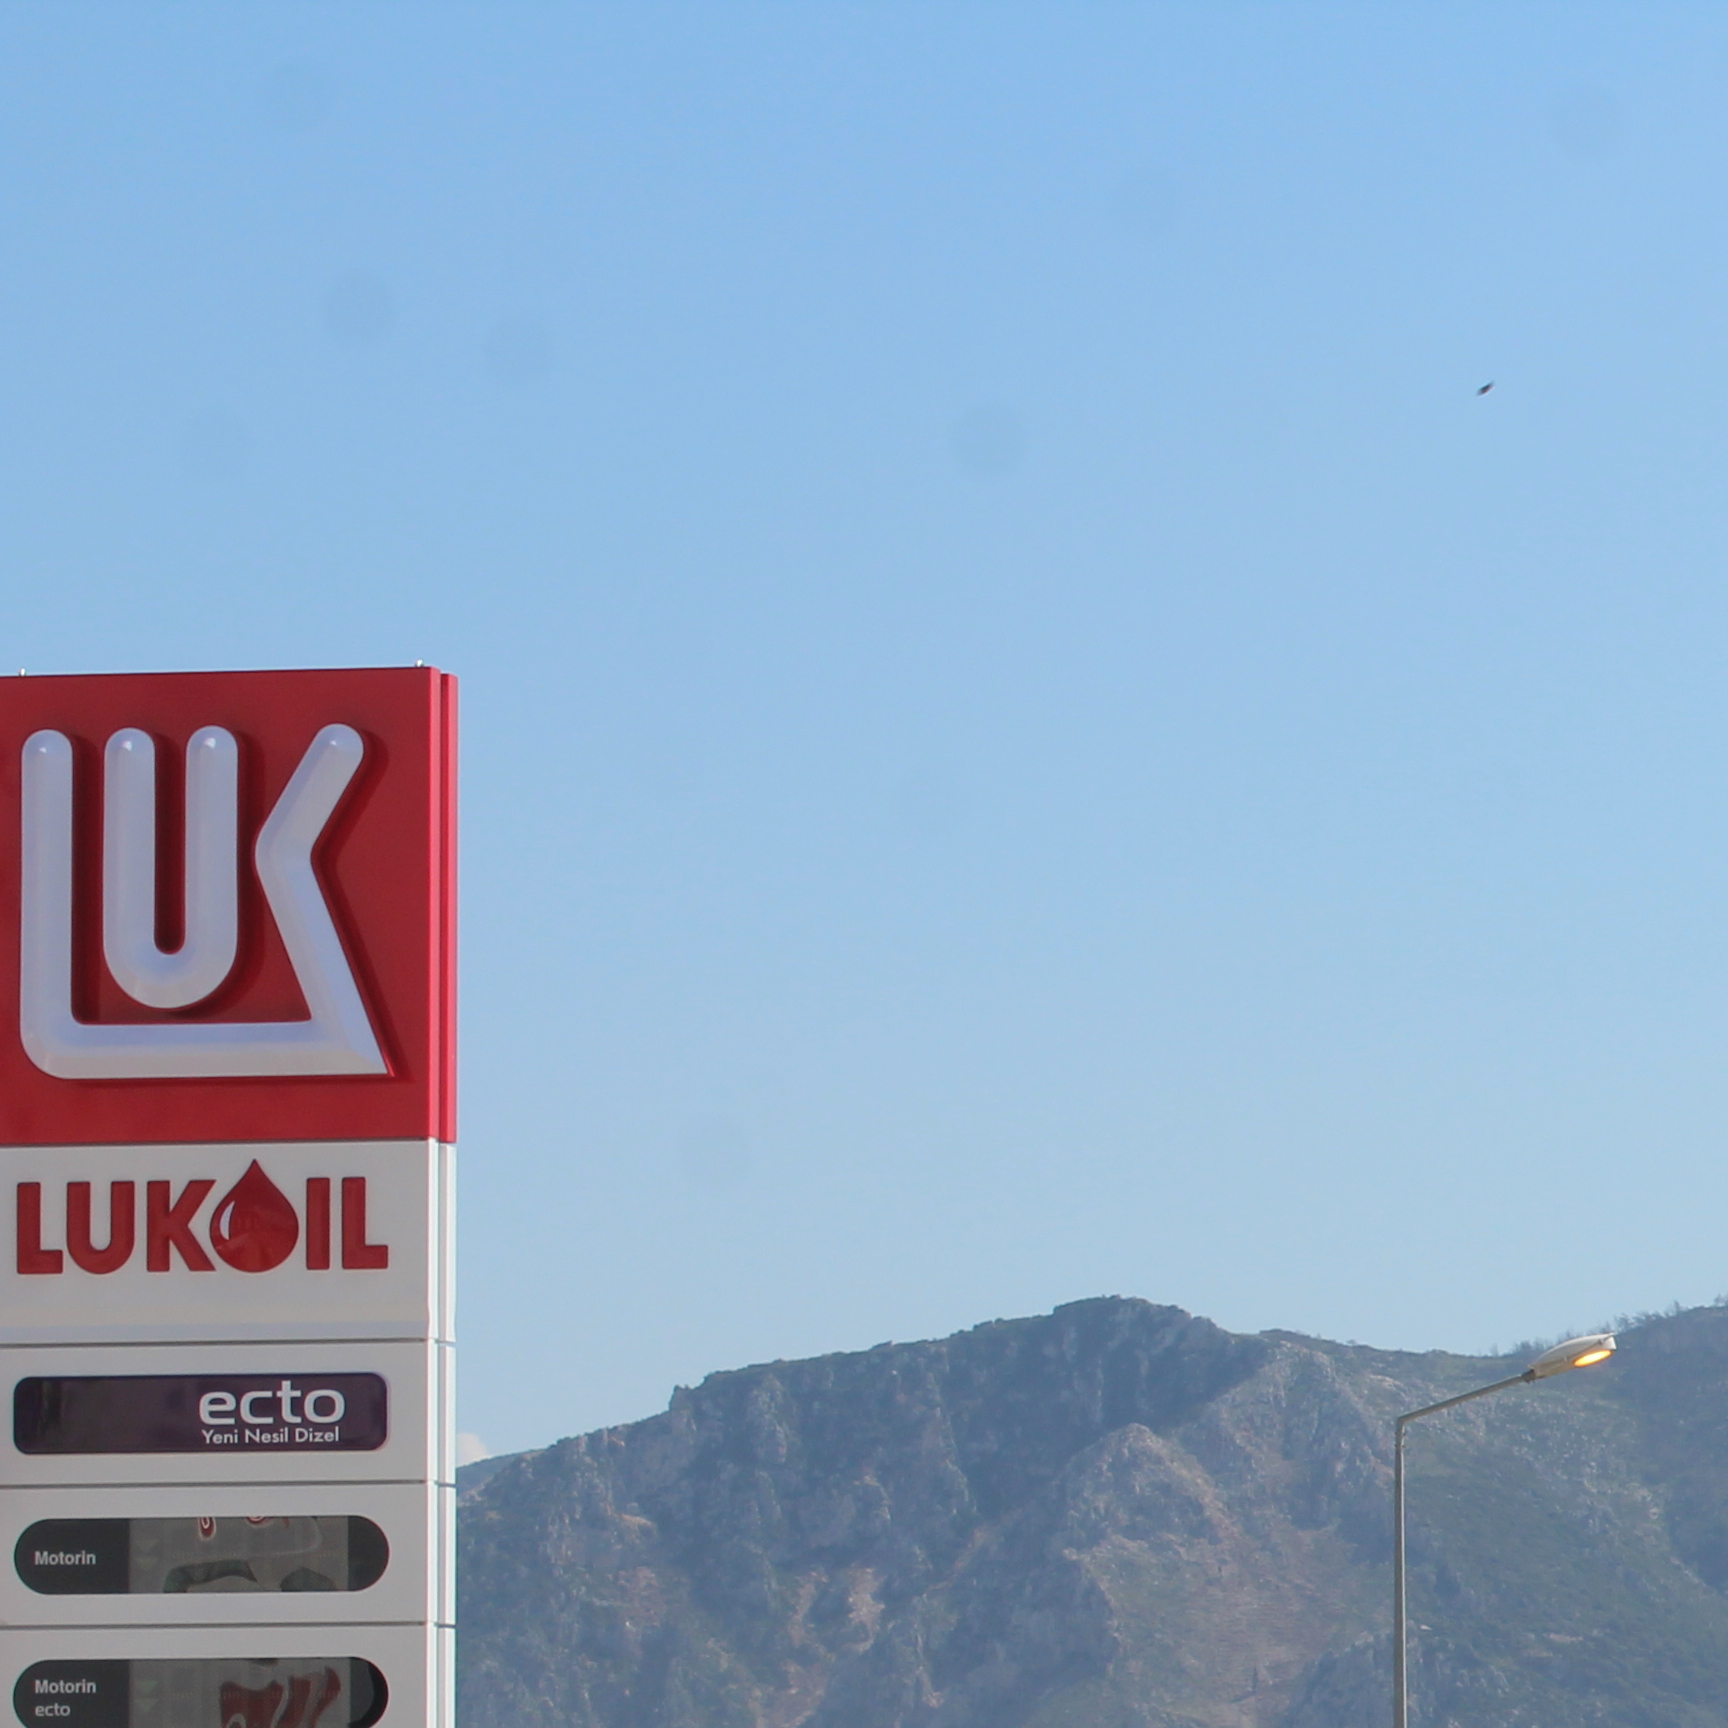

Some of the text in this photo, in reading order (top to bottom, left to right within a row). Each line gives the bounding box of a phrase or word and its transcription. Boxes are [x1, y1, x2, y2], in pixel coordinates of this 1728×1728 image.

[20, 723, 390, 1079] LUK
[17, 1159, 388, 1274] LUKOIL
[199, 1380, 346, 1425] ecto
[202, 1426, 340, 1445] Yeni Nesil Dizel
[34, 1550, 97, 1567] Motorin
[34, 1678, 97, 1695] Motorin
[34, 1701, 71, 1717] ecto
